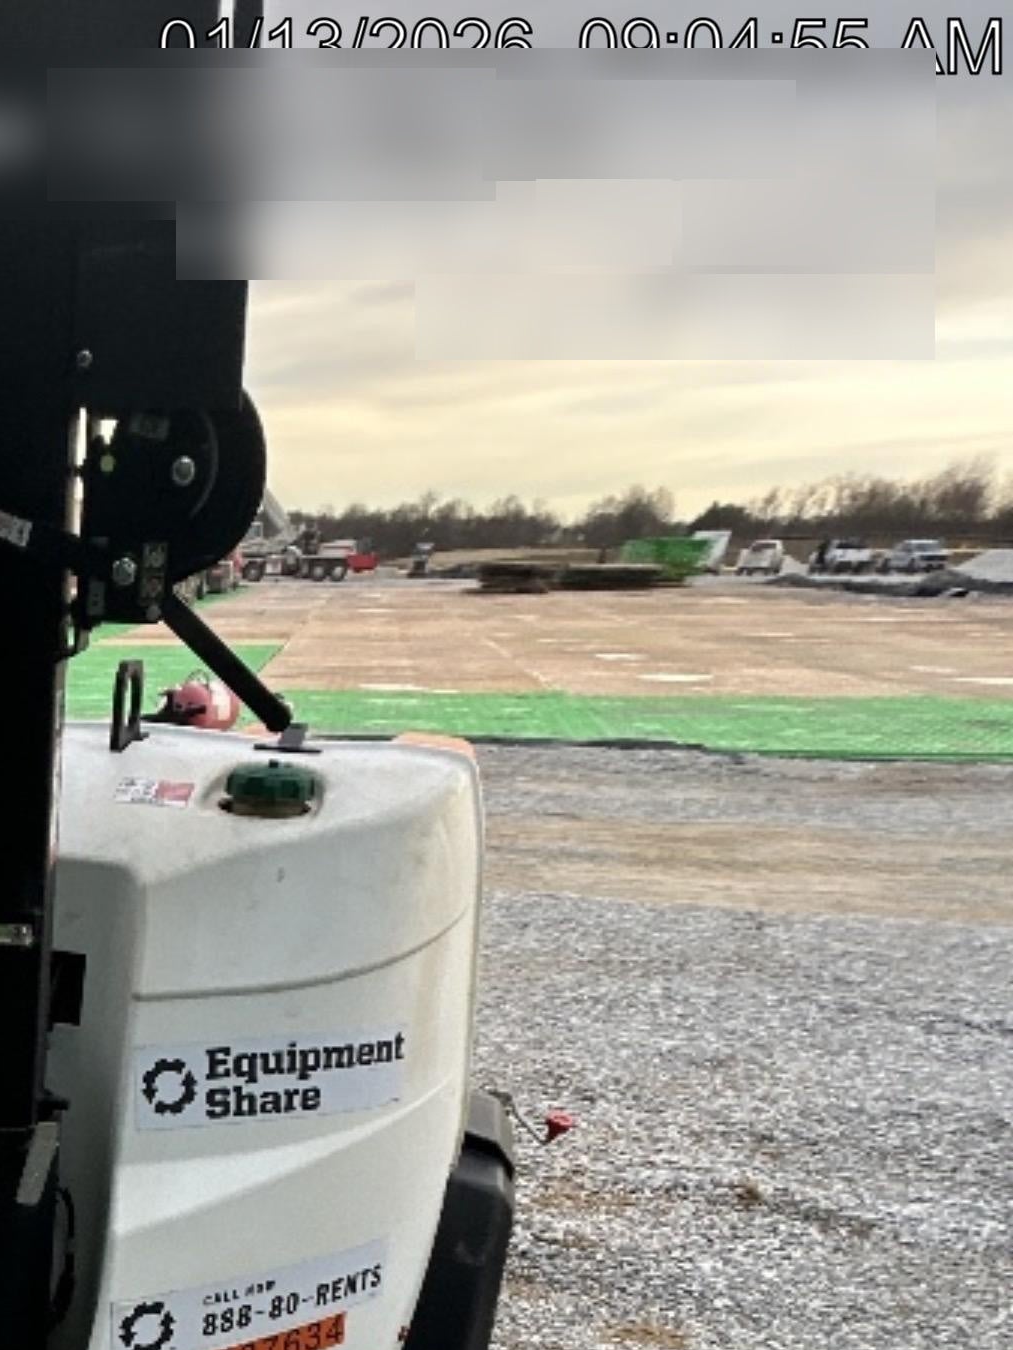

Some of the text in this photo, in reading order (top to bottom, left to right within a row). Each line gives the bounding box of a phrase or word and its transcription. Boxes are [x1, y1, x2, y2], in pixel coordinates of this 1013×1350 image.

[205, 1031, 405, 1084] Equipment
[205, 1085, 321, 1119] Share
[202, 1263, 382, 1336] 888-80-RENTS
